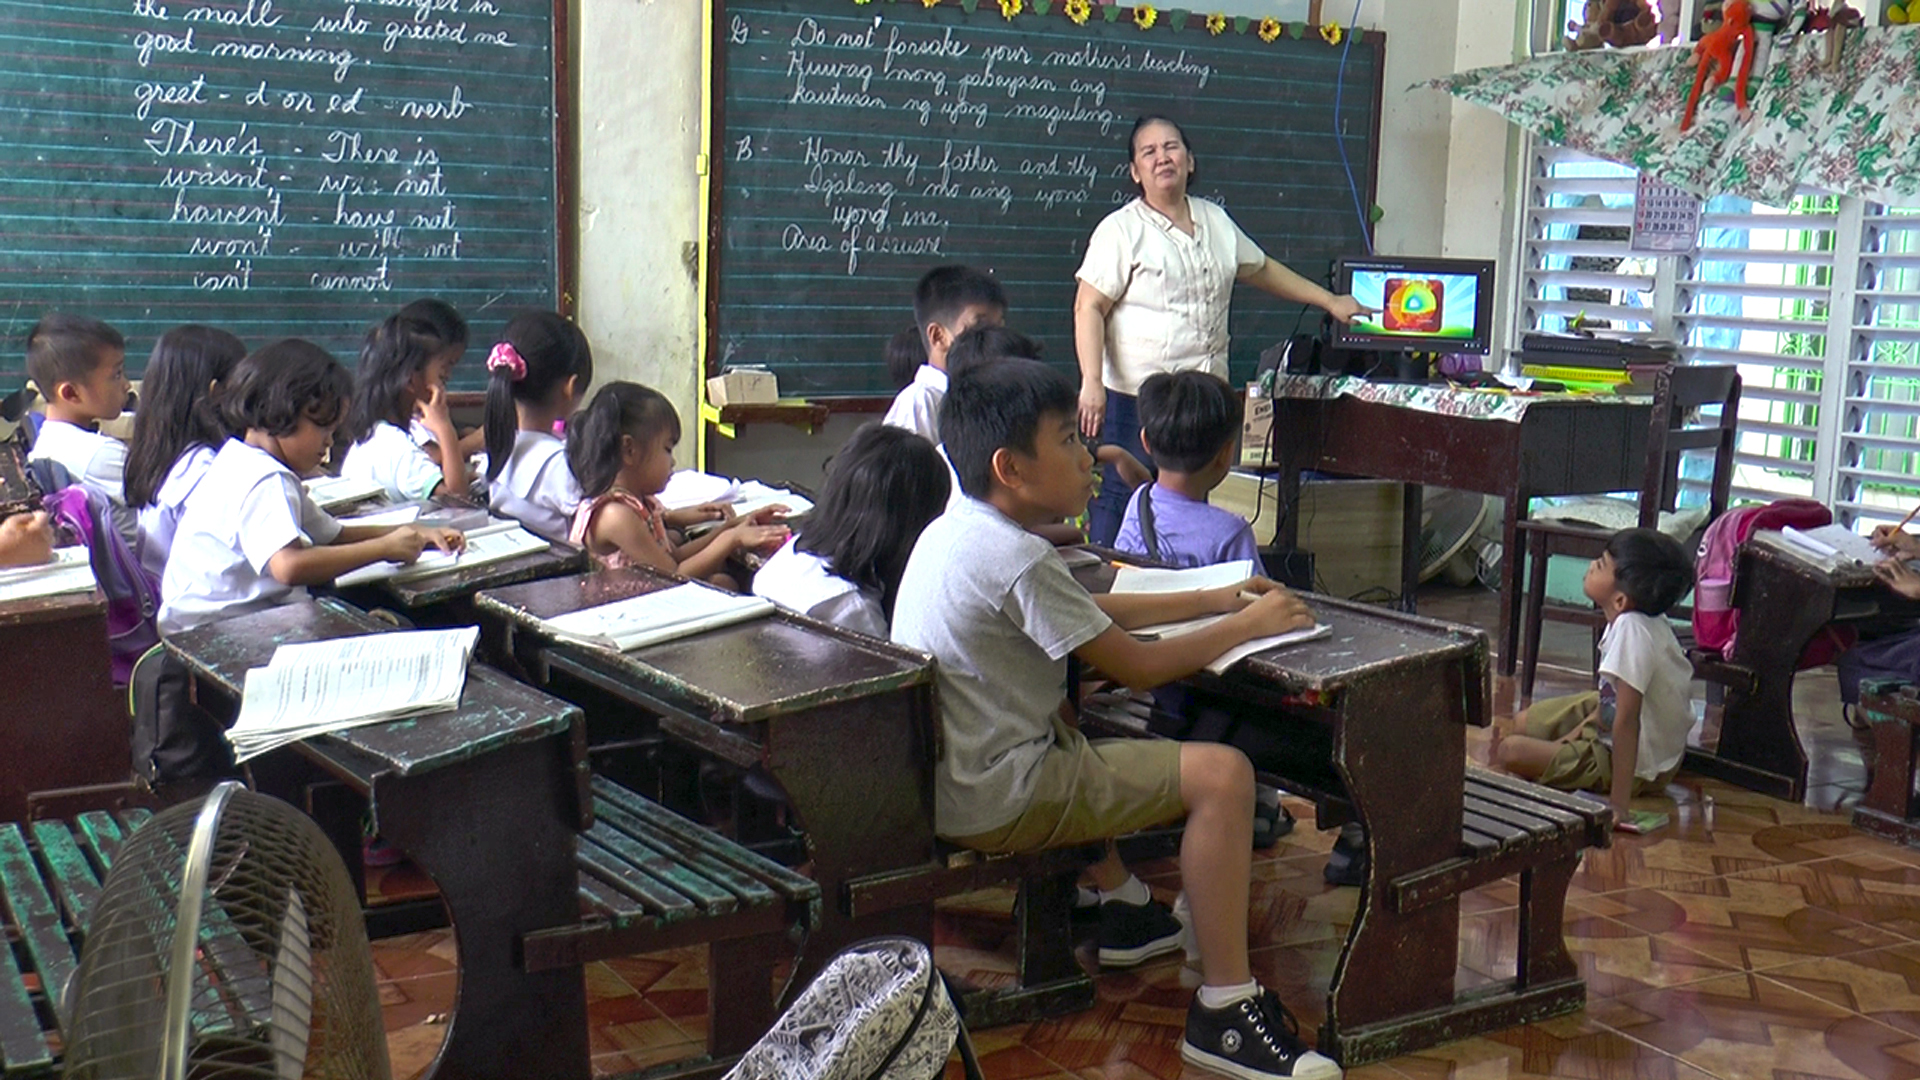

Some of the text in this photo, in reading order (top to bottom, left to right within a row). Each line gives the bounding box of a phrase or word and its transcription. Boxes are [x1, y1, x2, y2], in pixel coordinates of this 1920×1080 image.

[132, 0, 518, 52] the mall who greeted me
[790, 17, 827, 47] Do
[834, 26, 877, 48] not
[883, 26, 971, 73] forsake
[981, 45, 1033, 70] your
[1042, 42, 1133, 71] mother's
[133, 29, 199, 67] good
[133, 75, 209, 120] greet
[245, 82, 270, 106] d
[282, 93, 317, 113] or
[325, 87, 367, 115] ed
[400, 85, 473, 119] verb
[902, 98, 932, 126] ng
[1070, 78, 1107, 106] ang
[144, 118, 265, 157] There's
[321, 129, 401, 163] There
[414, 136, 441, 166] is
[735, 139, 753, 162] B
[799, 136, 871, 168] Honor
[882, 141, 919, 186] thy
[939, 139, 1000, 184] father
[1020, 153, 1060, 176] and
[1067, 154, 1098, 188] thy
[318, 172, 379, 196] was
[395, 167, 448, 197] not
[970, 183, 1014, 215] ang
[168, 187, 287, 226] haven't
[334, 195, 396, 226] have
[410, 200, 458, 229] not
[189, 226, 273, 256] won't
[338, 229, 404, 258] will
[782, 223, 832, 252] Area
[841, 223, 863, 275] of
[866, 235, 877, 251] a
[311, 258, 393, 291] cannot
